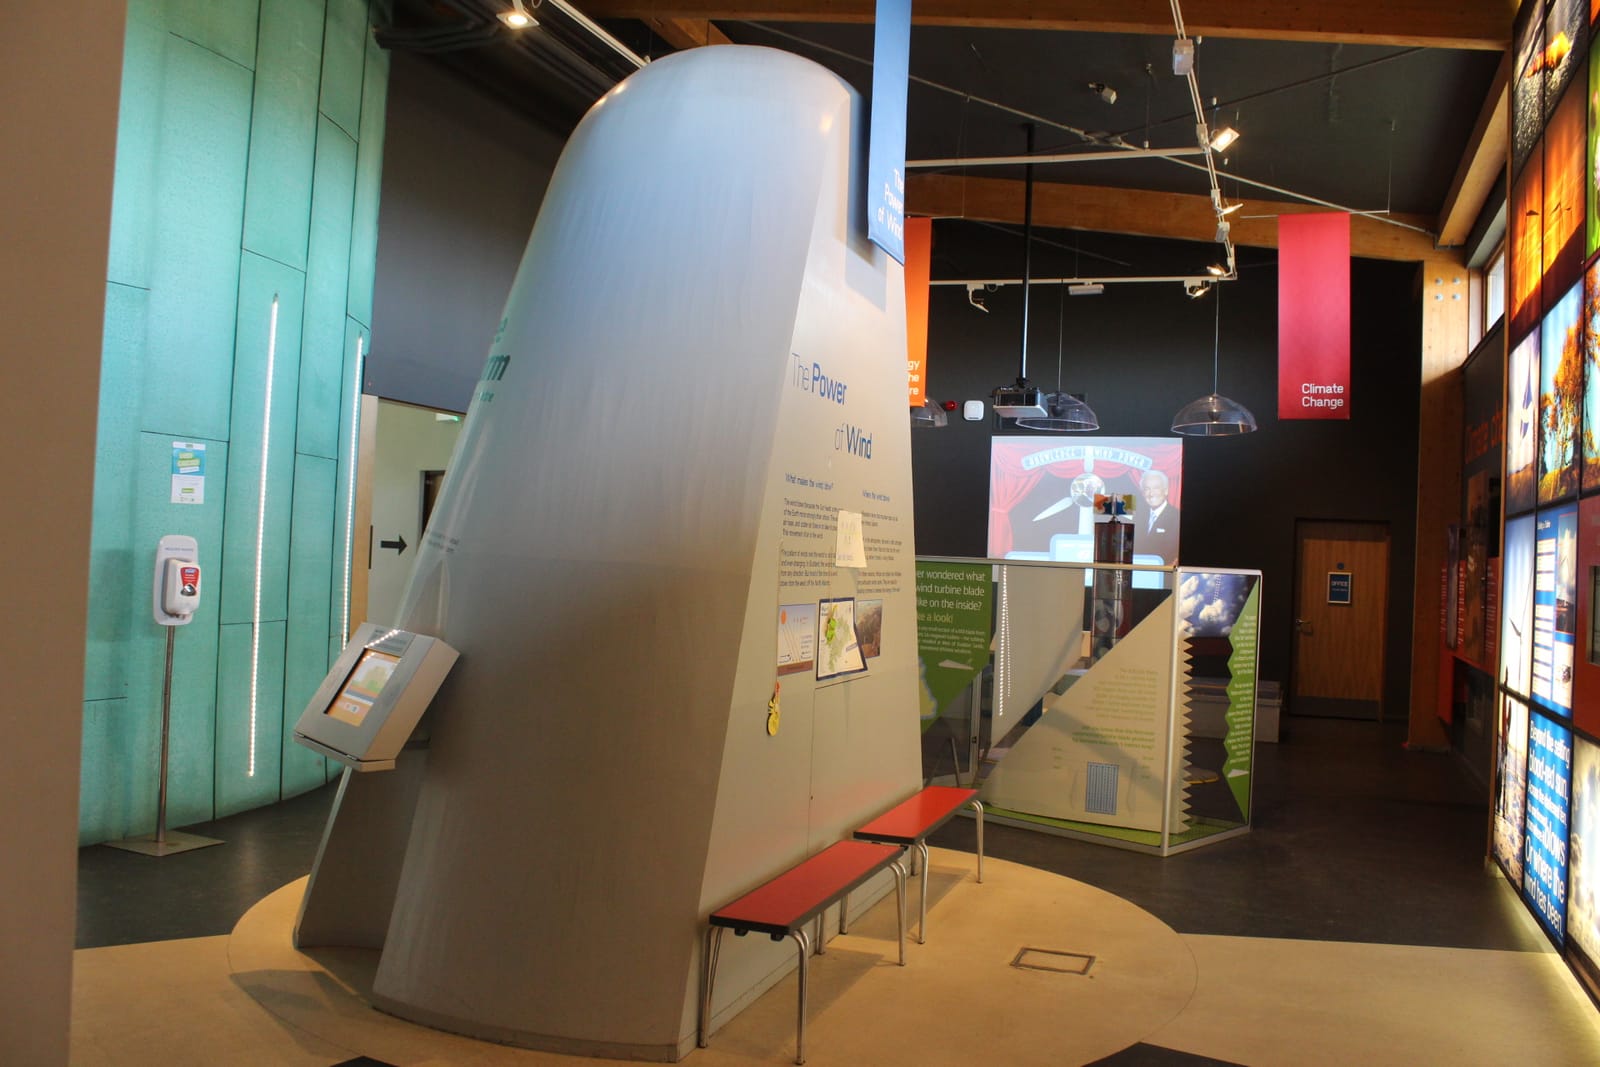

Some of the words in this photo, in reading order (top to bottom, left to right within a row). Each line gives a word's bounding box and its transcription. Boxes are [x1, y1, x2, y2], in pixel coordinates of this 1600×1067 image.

[878, 206, 885, 224] of
[791, 352, 810, 391] The
[811, 362, 847, 405] Power
[1302, 383, 1344, 394] Climate
[1302, 396, 1344, 410] Change
[834, 423, 844, 451] of
[846, 424, 873, 460] Wind
[926, 569, 964, 580] wondered
[966, 571, 986, 582] what
[934, 584, 962, 595] turbine
[963, 585, 985, 596] blade
[929, 599, 939, 608] on
[942, 599, 954, 608] the
[956, 599, 982, 611] inside?
[1529, 747, 1555, 790] blood-red
[1544, 817, 1566, 867] blows
[1525, 835, 1534, 865] Or
[1533, 848, 1553, 889] where
[1552, 863, 1565, 904] the
[1536, 877, 1547, 915] has
[1546, 887, 1564, 937] been.
